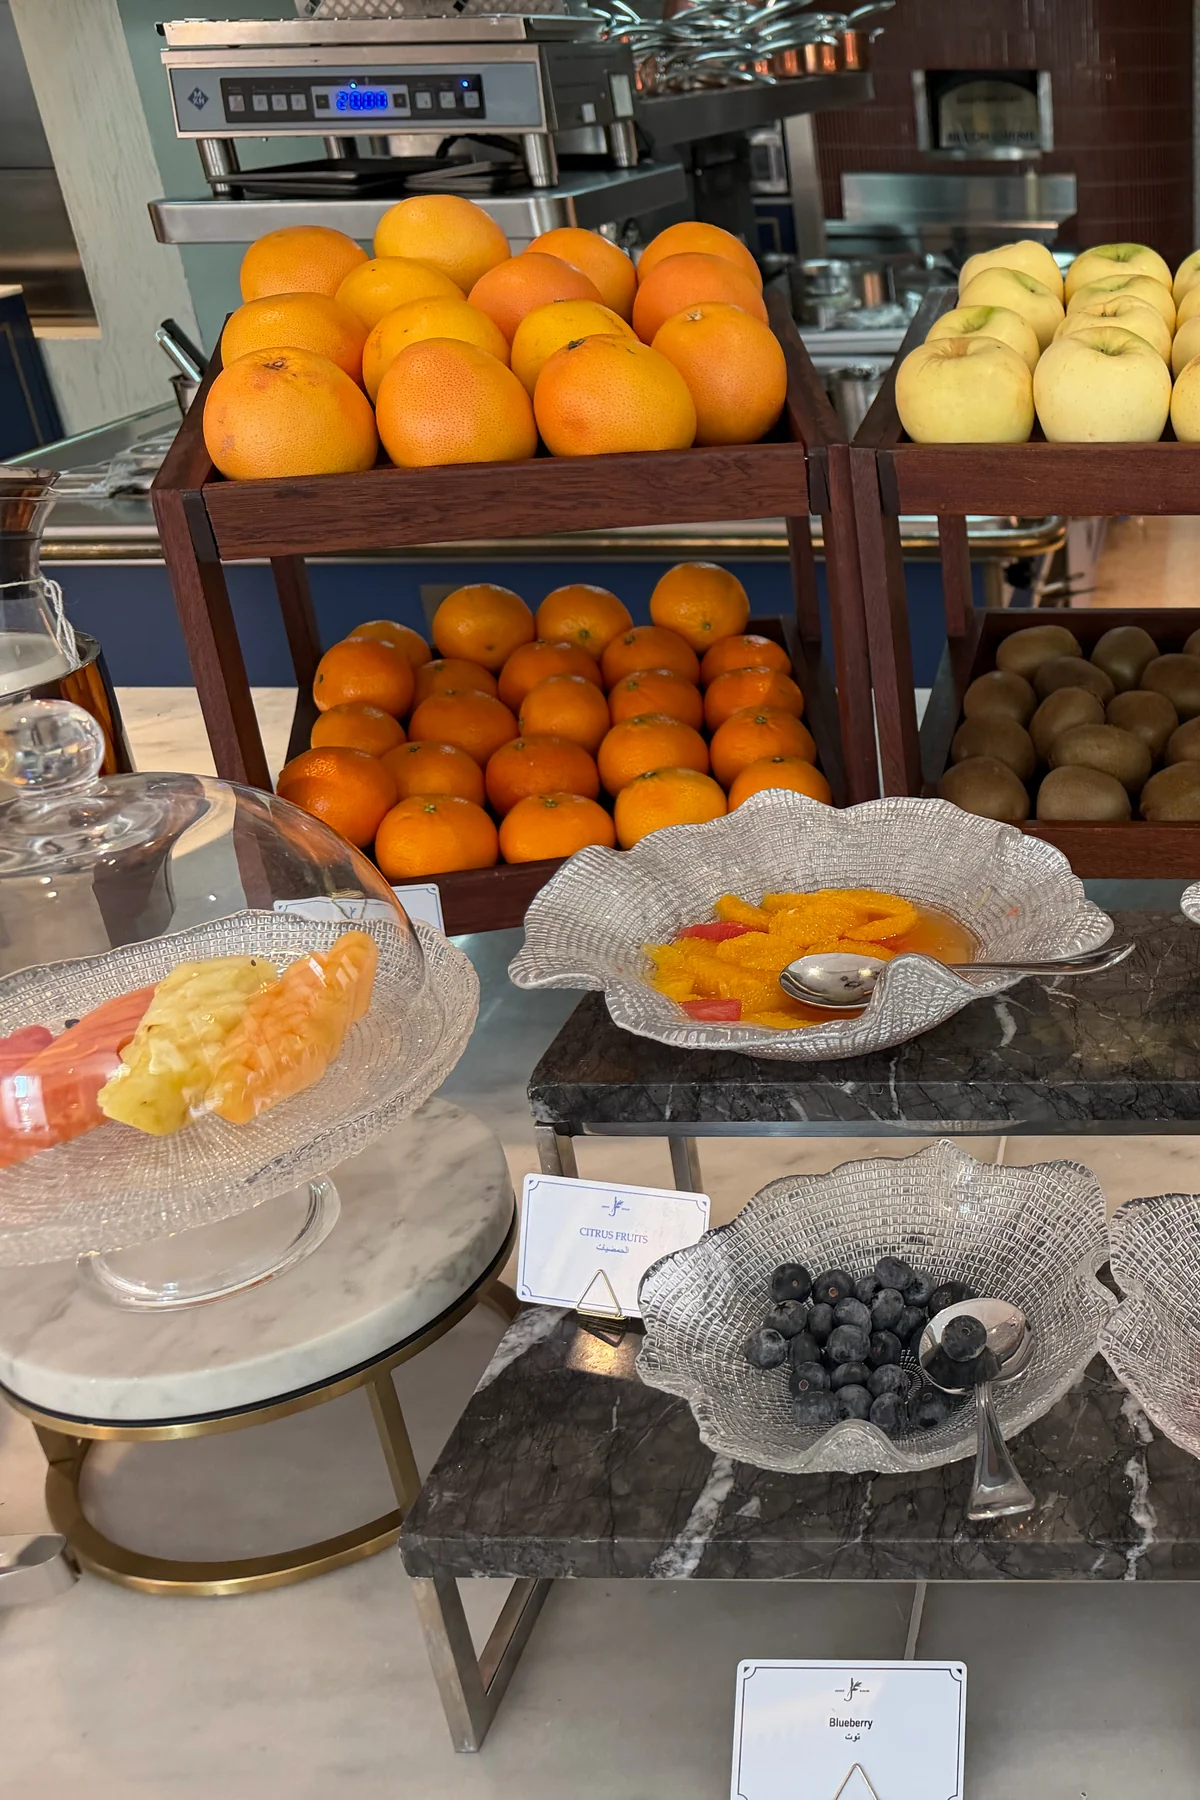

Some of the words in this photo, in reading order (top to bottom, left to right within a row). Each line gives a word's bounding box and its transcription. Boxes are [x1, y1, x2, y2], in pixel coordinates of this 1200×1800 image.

[579, 1227, 614, 1240] CITRUS
[615, 1231, 649, 1244] FRUITS
[829, 1717, 874, 1730] Blueberry
[844, 1732, 861, 1743] توت
